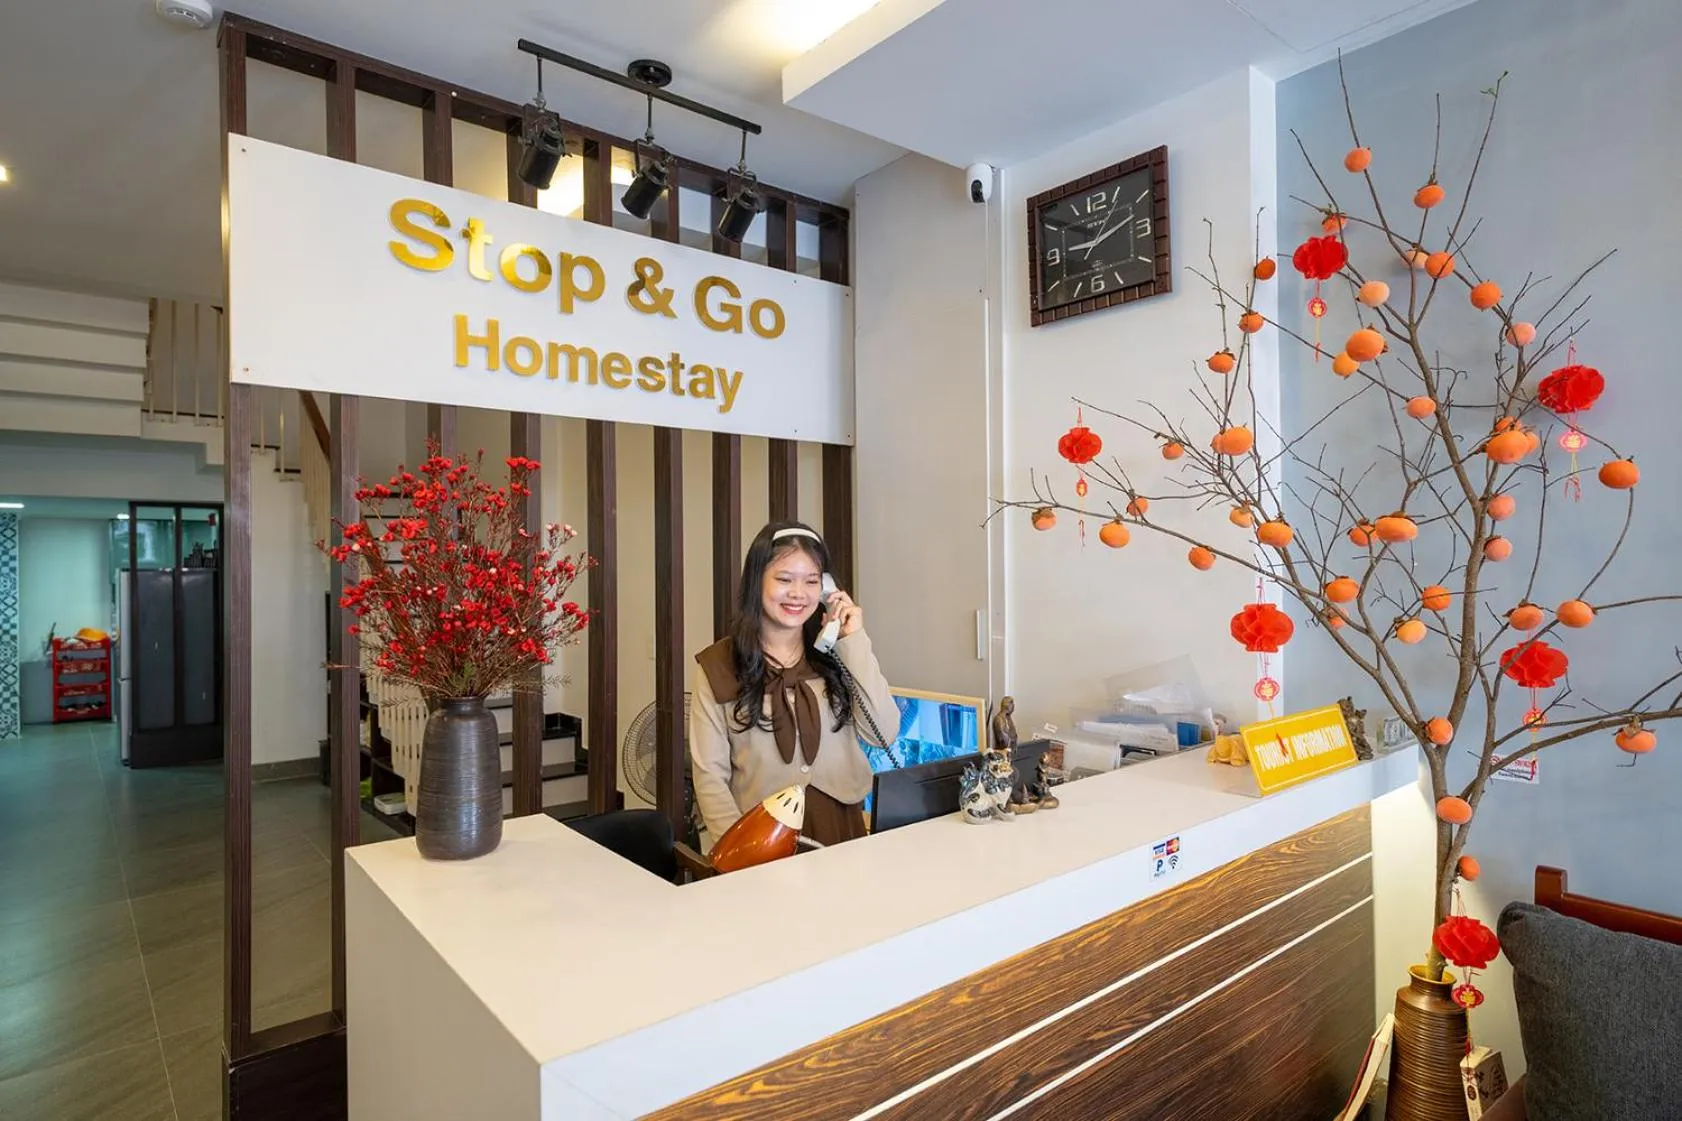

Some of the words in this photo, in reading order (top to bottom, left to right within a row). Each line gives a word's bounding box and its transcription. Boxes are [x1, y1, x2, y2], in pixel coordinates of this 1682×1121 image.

[1086, 191, 1107, 213] 12
[1136, 217, 1151, 239] 3
[1046, 247, 1060, 266] 9
[388, 199, 606, 315] Stop
[627, 257, 677, 318] &
[694, 276, 786, 339] Go
[1090, 274, 1105, 293] 6
[453, 313, 744, 414] Homestay
[1291, 724, 1348, 760] INFORMATION
